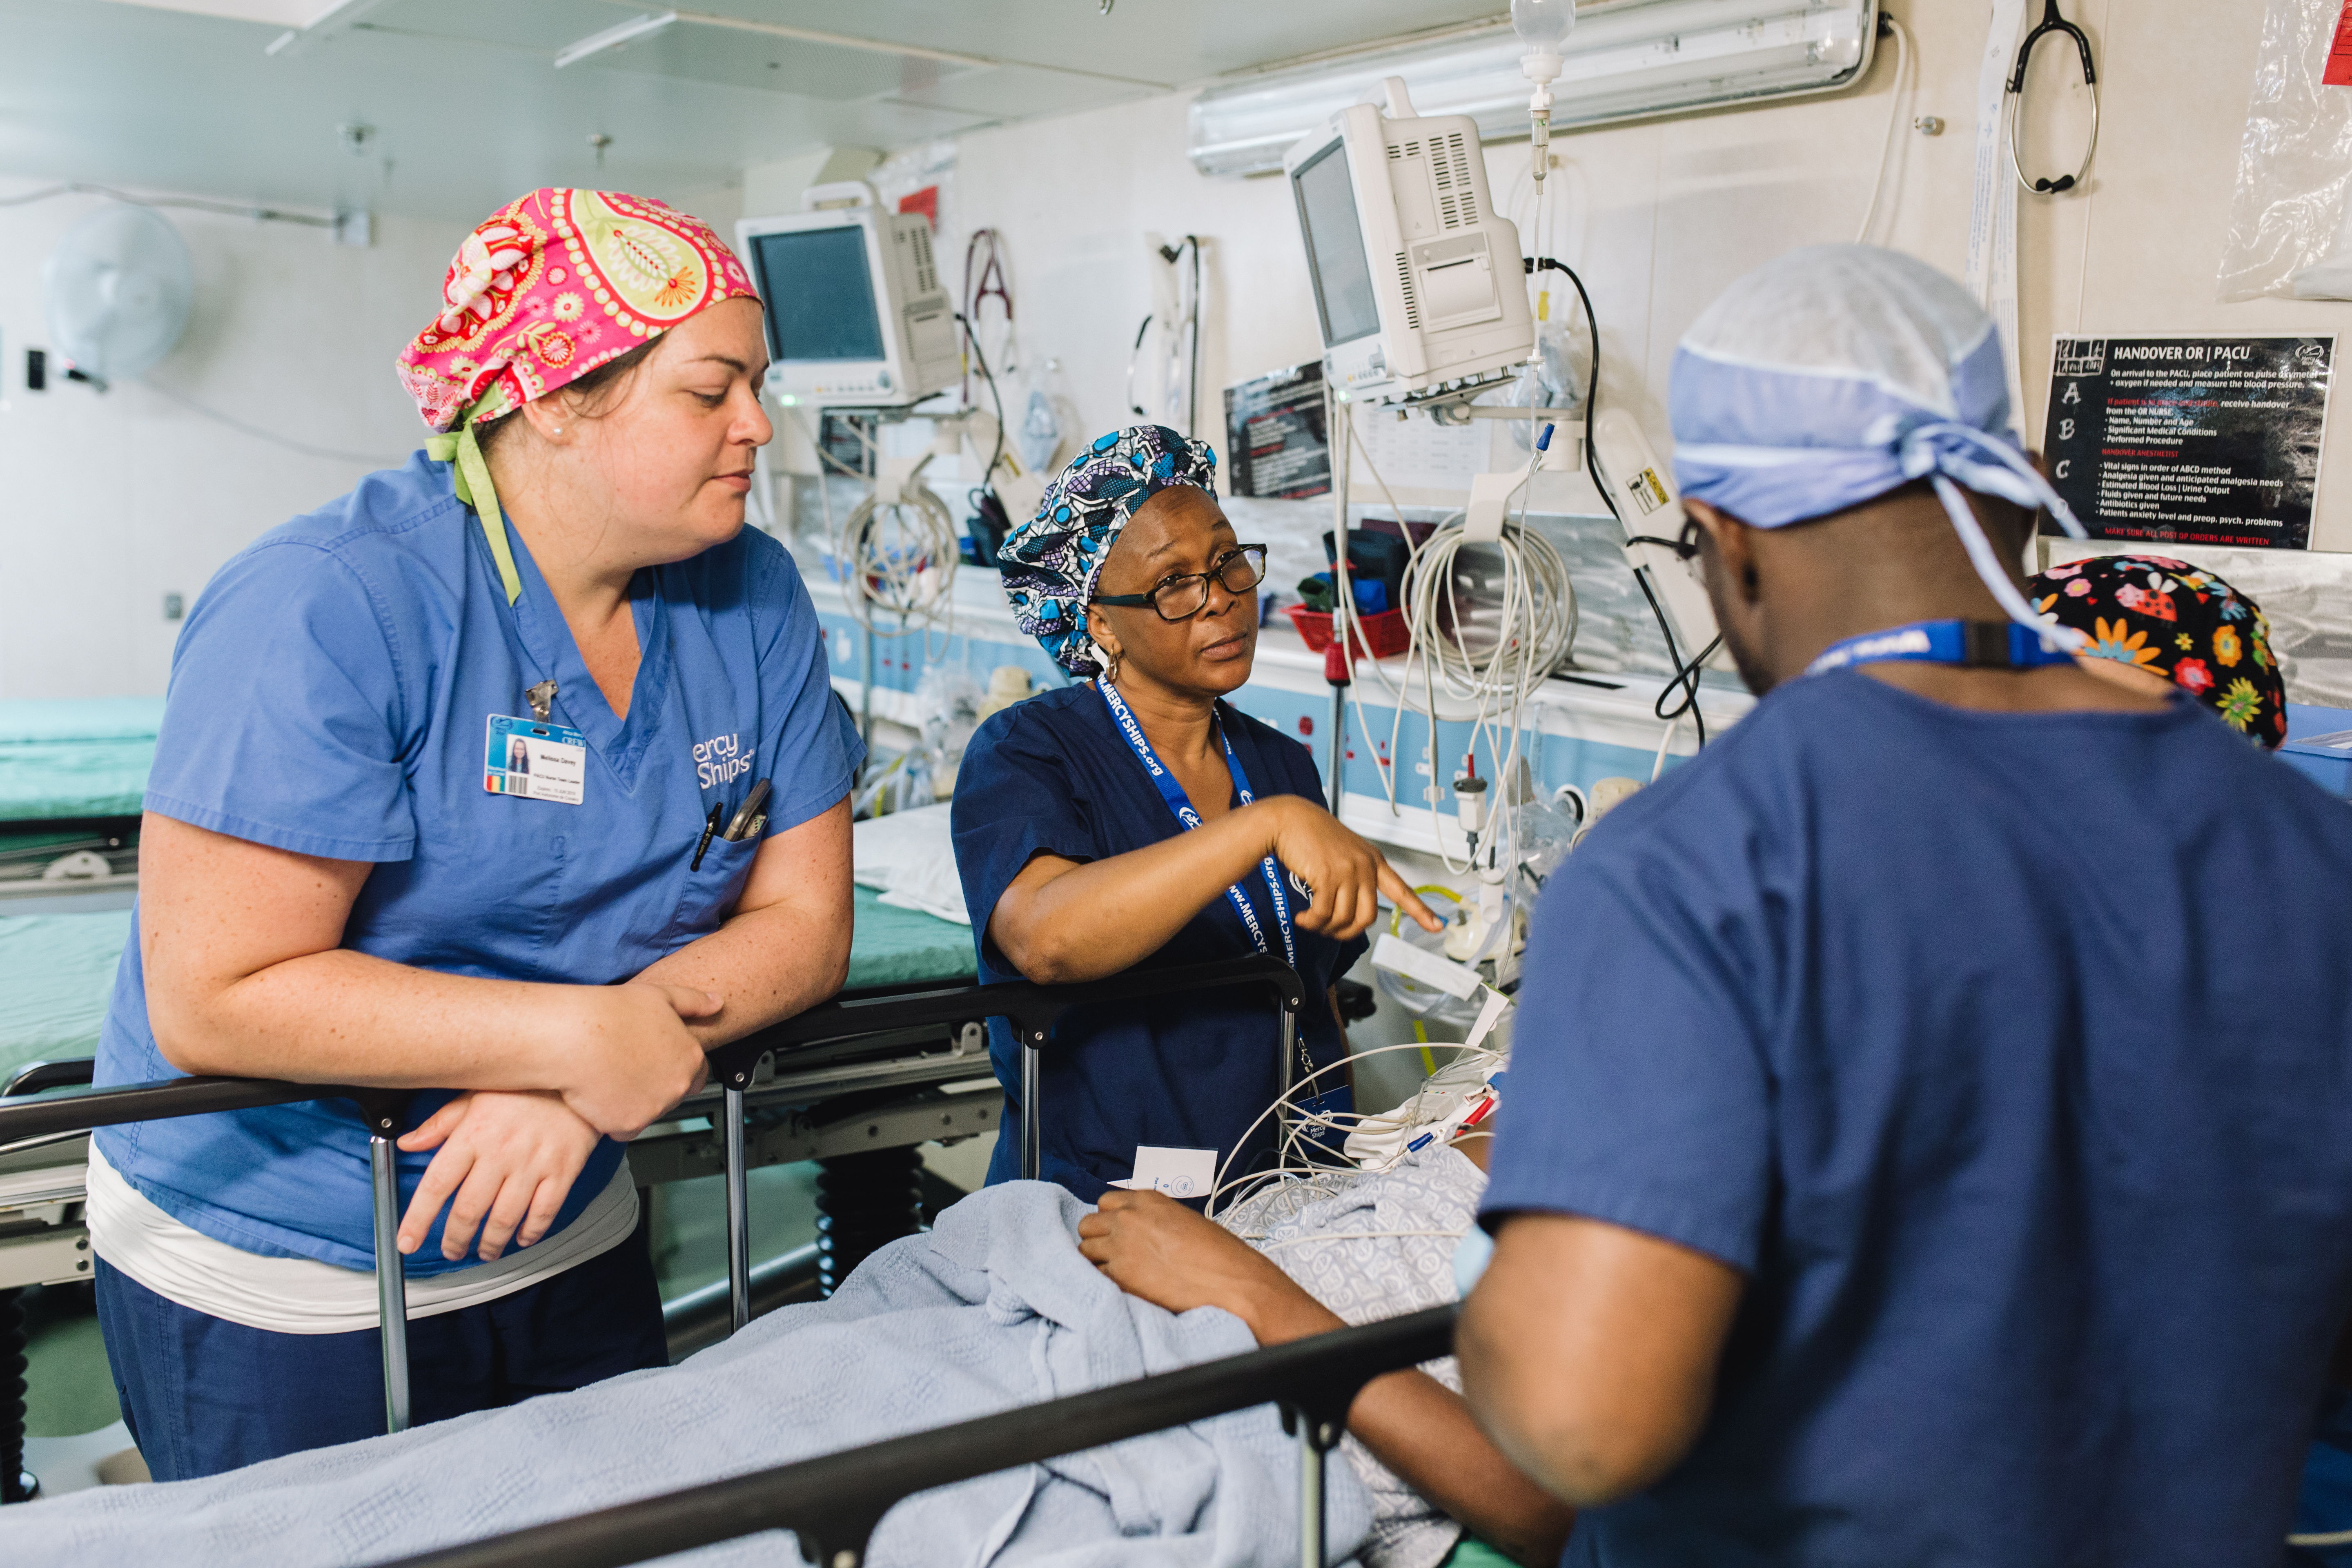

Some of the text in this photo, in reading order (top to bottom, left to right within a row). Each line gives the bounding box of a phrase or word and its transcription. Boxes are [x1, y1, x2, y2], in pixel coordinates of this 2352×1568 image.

[2114, 347, 2182, 359] HANDOVER
[2185, 347, 2204, 359] OR
[2214, 347, 2250, 359] PACU
[2111, 369, 2120, 377] On
[2122, 369, 2145, 378] arrival
[2156, 370, 2168, 378] the
[2169, 370, 2190, 378] PACU,
[2192, 370, 2213, 379] place
[2214, 370, 2242, 379] patient
[2256, 371, 2277, 379] pulse
[2115, 380, 2142, 388] oxygen
[2143, 379, 2149, 387] if
[2149, 379, 2177, 388] needed
[2178, 379, 2193, 388] and
[2244, 380, 2266, 388] blood
[2062, 382, 2081, 404] A
[2107, 397, 2113, 405] If
[2114, 398, 2139, 406] patient
[2252, 400, 2290, 408] handover
[2106, 407, 2123, 415] from
[2124, 407, 2136, 415] the
[2109, 416, 2194, 427] Name, Number and Age
[2059, 418, 2075, 440] B
[2108, 425, 2217, 437] Significant Medical Conditions
[2107, 435, 2183, 445] Performed Procedure
[2102, 448, 2136, 457] HANDOVER
[2056, 459, 2071, 479] C
[2104, 461, 2120, 470] Vital
[2121, 462, 2139, 472] signs
[2149, 464, 2169, 472] order
[2171, 464, 2179, 472] of
[2180, 465, 2200, 473] ABCD
[2201, 466, 2231, 475] method
[2103, 471, 2283, 487] Analgesia given and anticipated analgesia needs
[2102, 480, 2137, 490] Estimated
[2139, 482, 2159, 490] Blood
[2161, 483, 2177, 492] Loss
[2182, 484, 2202, 493] Urine
[2204, 485, 2230, 495] Output
[2101, 489, 2206, 503] Fluids given and future needs
[2100, 498, 2160, 510] Antibiotics given
[2100, 508, 2283, 527] Patients anxiety level and preop. psych. problems
[2105, 527, 2124, 535] MAKE
[2160, 531, 2176, 539] POST
[2190, 533, 2218, 542] ORDERS
[2220, 535, 2234, 543] ARE
[2236, 536, 2269, 545] WRITTEN
[562, 737, 584, 747] CREW
[693, 733, 738, 763] ercy
[1310, 1125, 1325, 1134] Mercy
[1312, 1131, 1325, 1139] Ships
